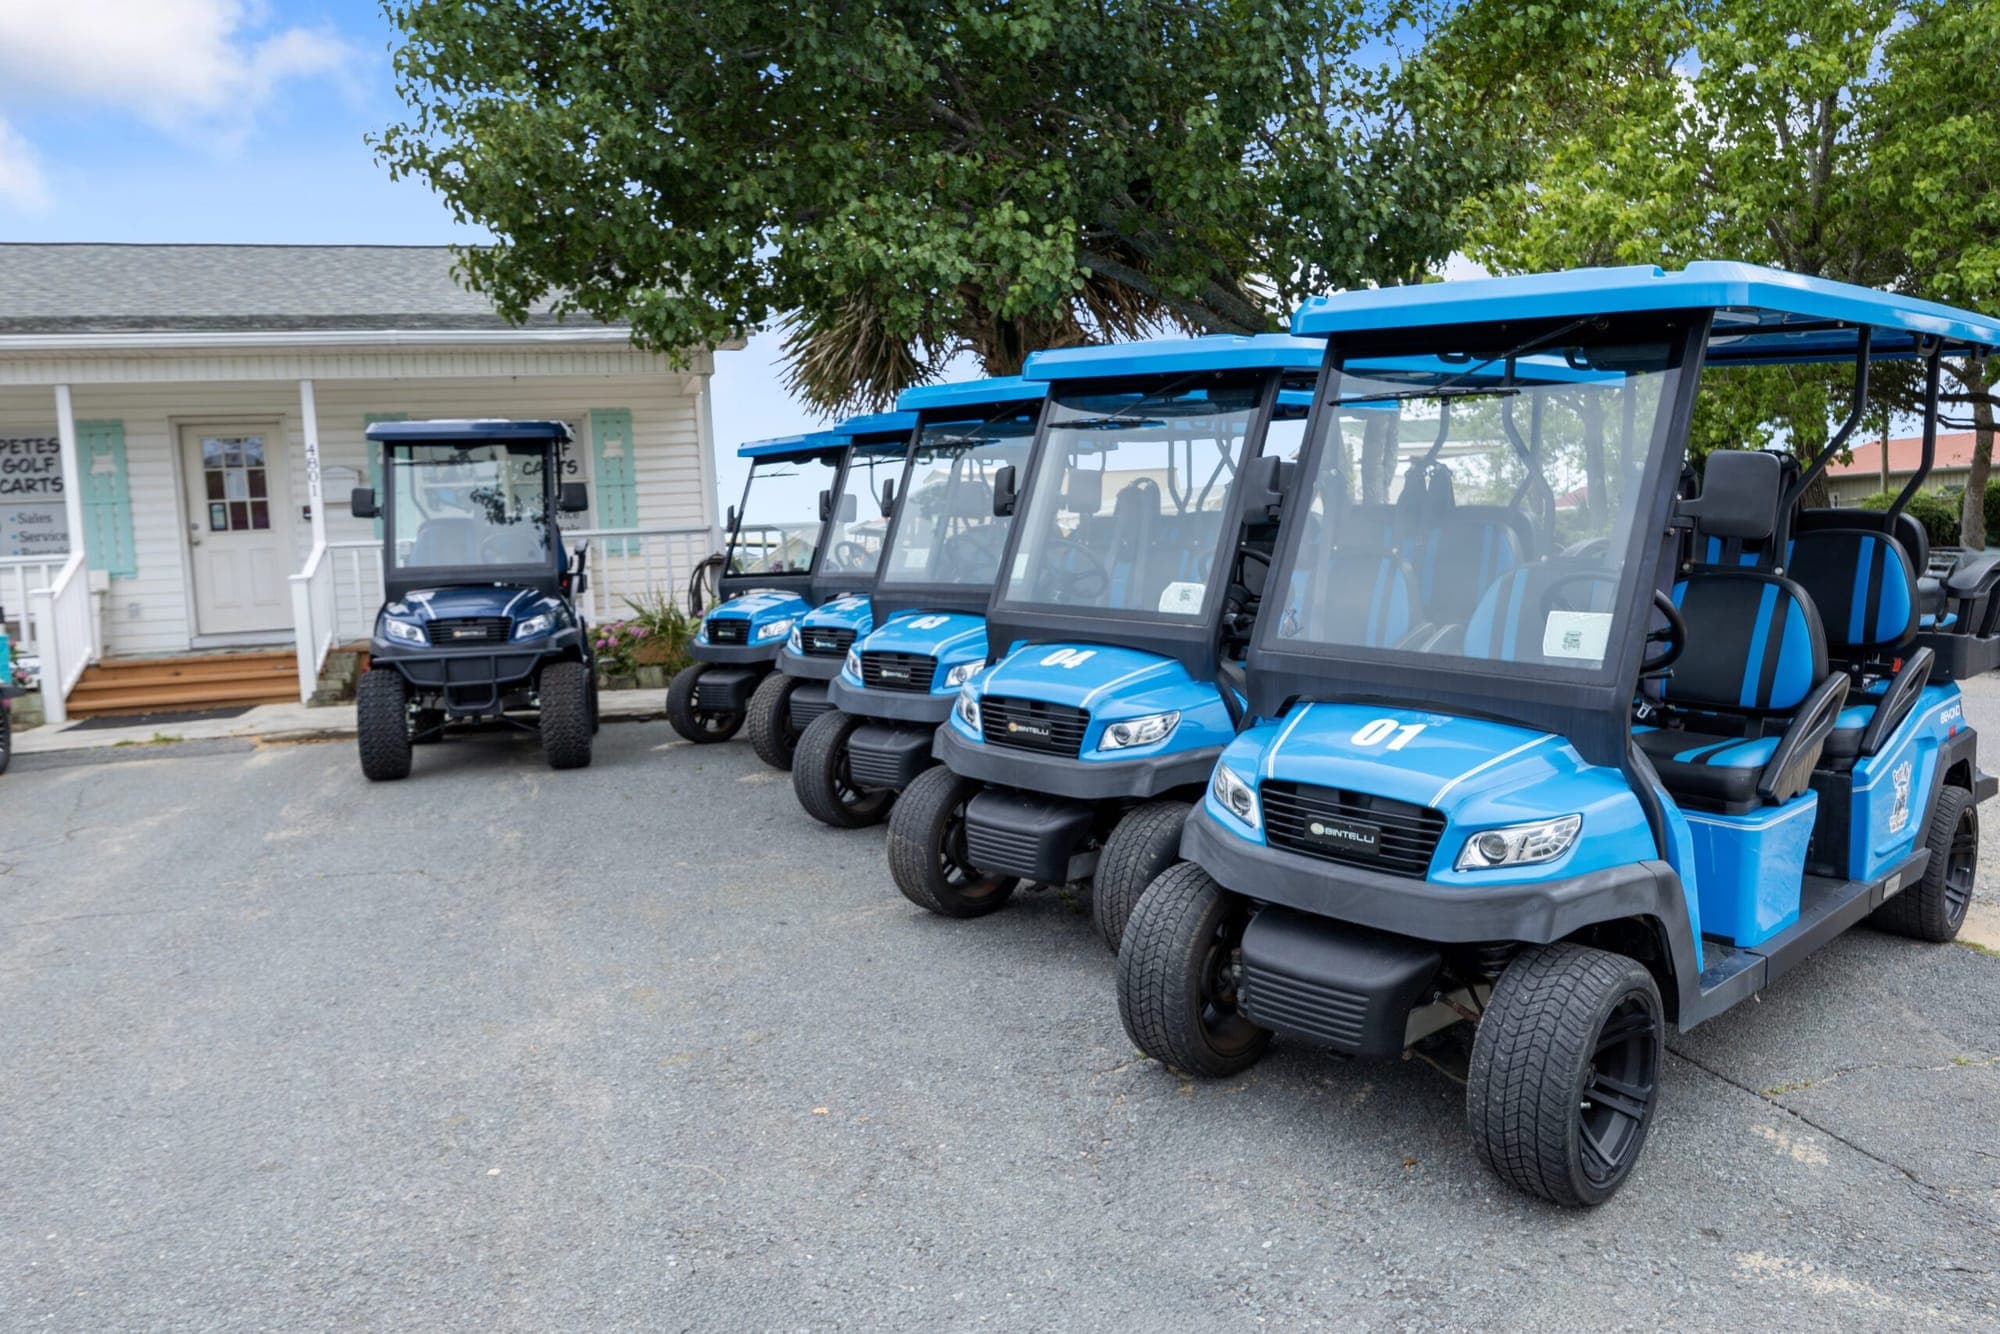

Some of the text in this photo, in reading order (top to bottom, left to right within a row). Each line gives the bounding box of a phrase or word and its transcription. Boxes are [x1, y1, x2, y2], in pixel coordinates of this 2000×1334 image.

[0, 438, 61, 455] PETES
[2, 457, 55, 474] GOLF
[305, 444, 319, 497] 4801
[0, 476, 64, 494] CARTS
[17, 511, 52, 525] Sales
[1040, 648, 1097, 669] 04
[1351, 718, 1427, 751] 01
[1325, 826, 1375, 844] BINTELLI
